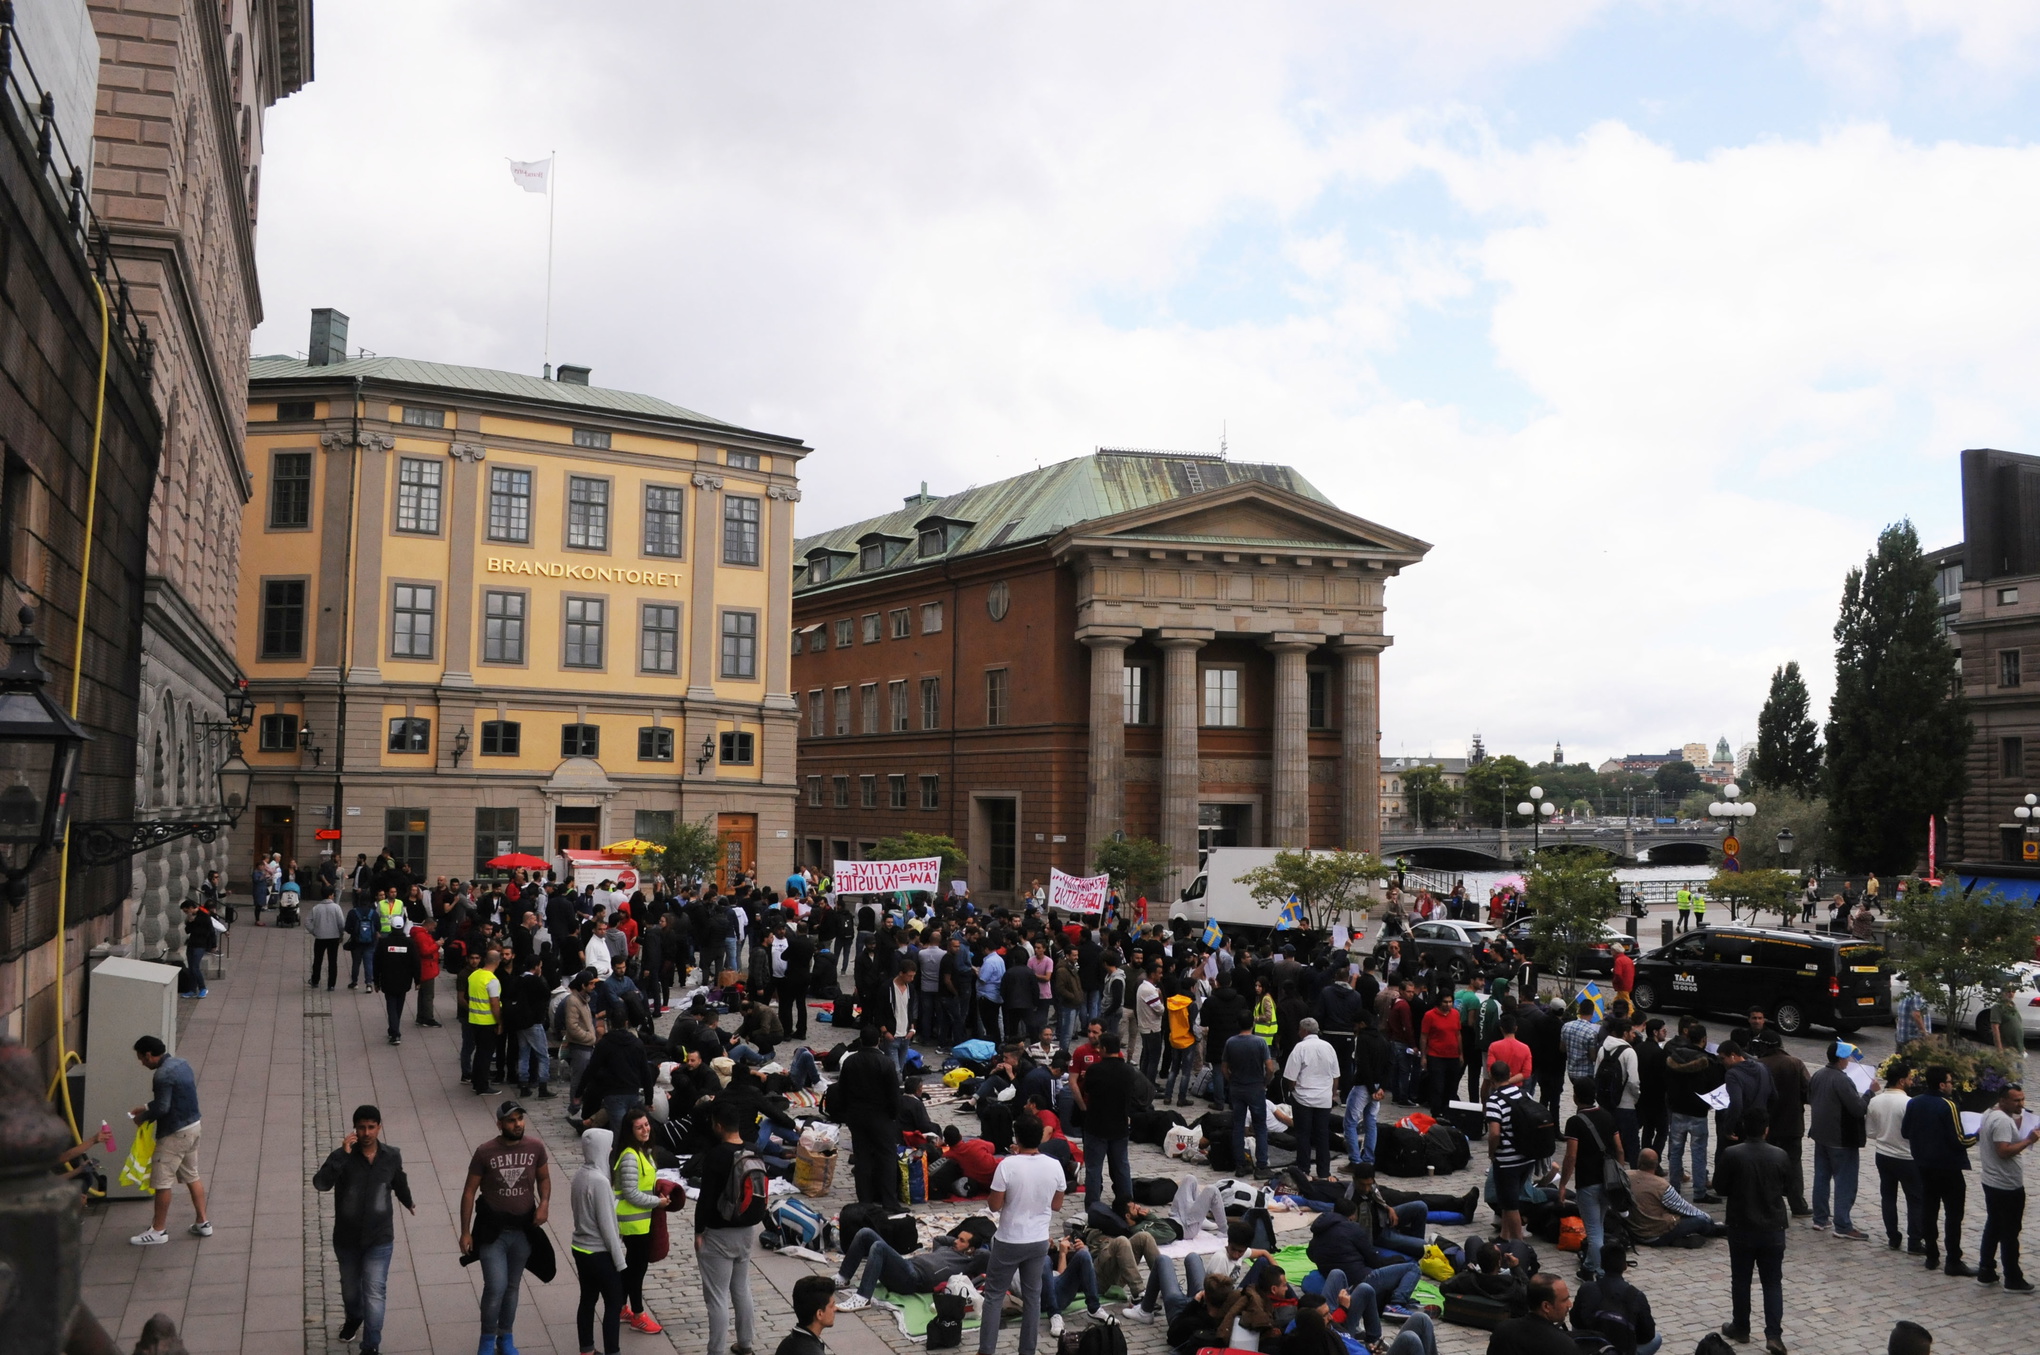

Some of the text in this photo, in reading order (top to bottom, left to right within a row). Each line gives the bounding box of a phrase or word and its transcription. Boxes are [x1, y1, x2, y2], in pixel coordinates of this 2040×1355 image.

[487, 557, 683, 588] BRANDKONTORET
[1674, 973, 1695, 983] TAXI
[1176, 1135, 1194, 1143] WE
[490, 1153, 535, 1169] GENIUS
[503, 1169, 521, 1178] 1985
[498, 1187, 525, 1197] COOL
